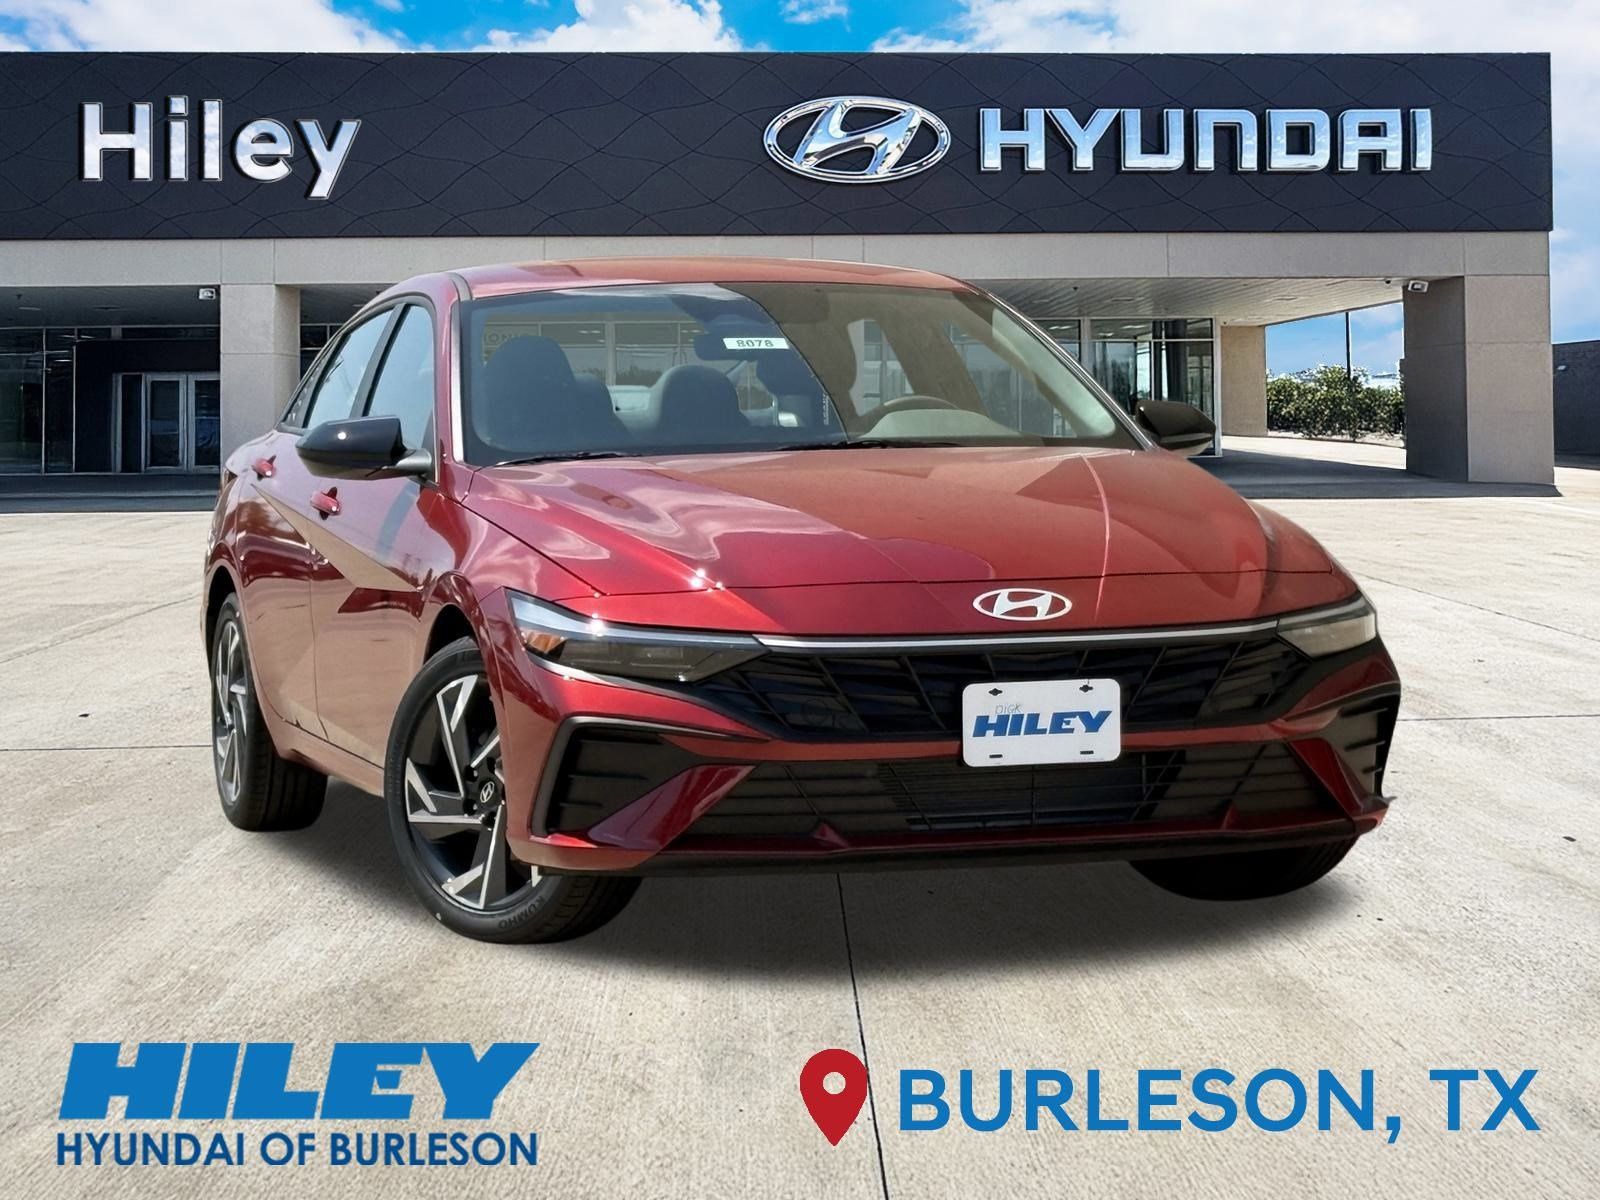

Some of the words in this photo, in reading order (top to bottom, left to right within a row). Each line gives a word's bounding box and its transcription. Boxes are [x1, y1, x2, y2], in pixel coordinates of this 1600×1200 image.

[80, 95, 361, 200] Hiley
[979, 108, 1433, 172] HYUNDAI
[972, 710, 1113, 738] HILEY
